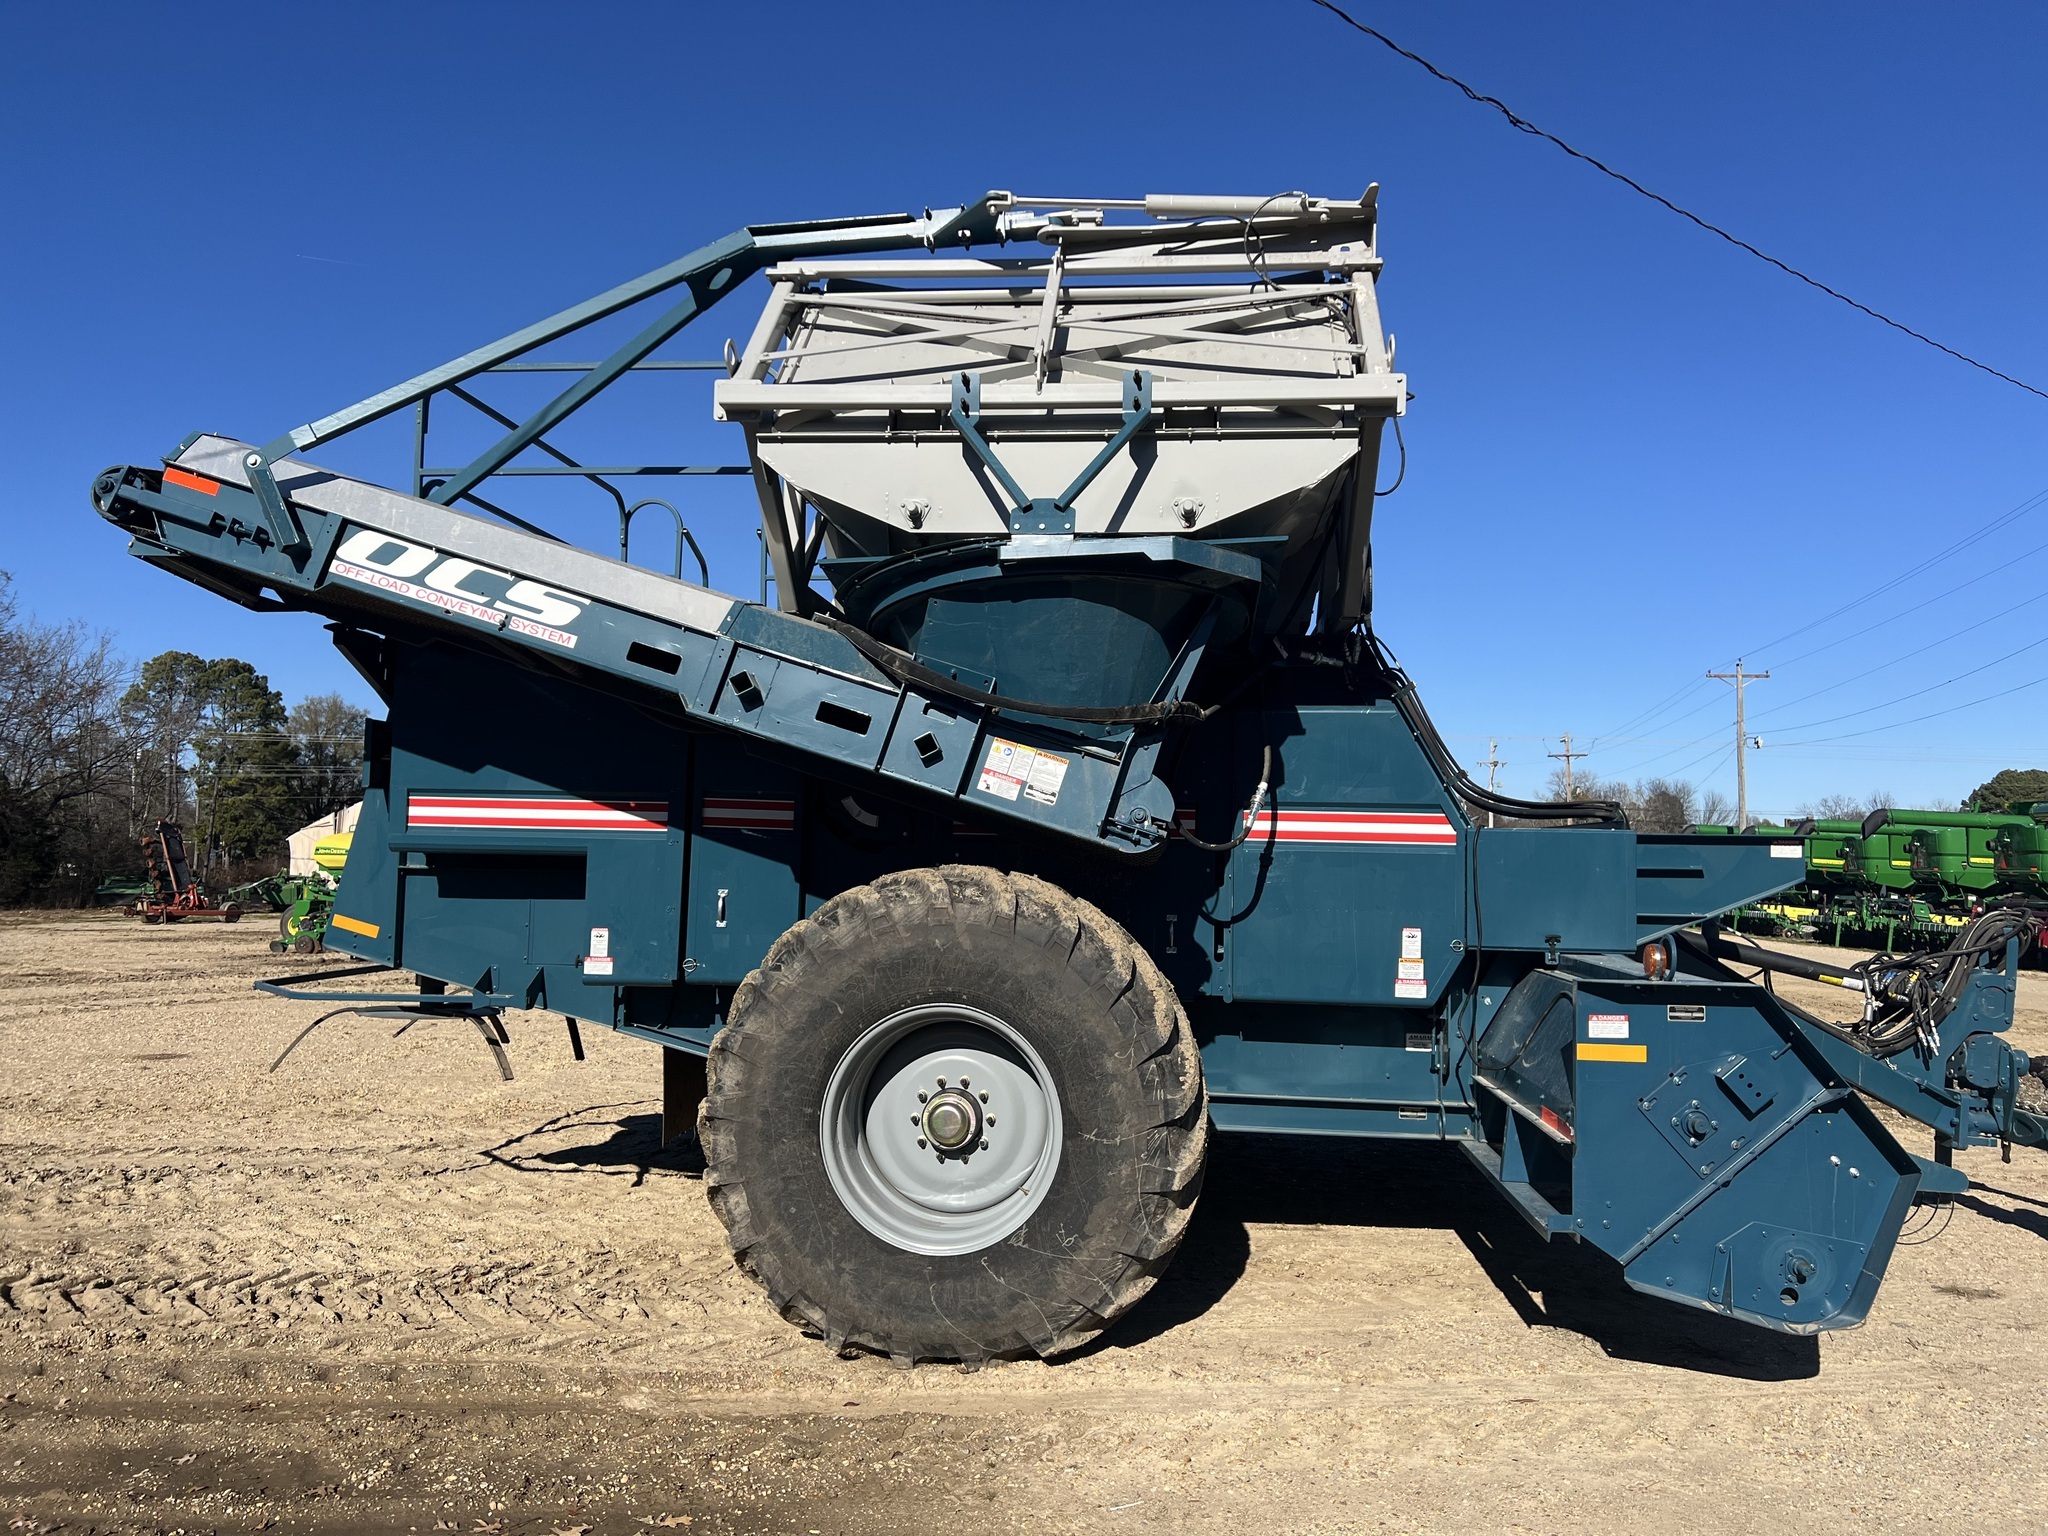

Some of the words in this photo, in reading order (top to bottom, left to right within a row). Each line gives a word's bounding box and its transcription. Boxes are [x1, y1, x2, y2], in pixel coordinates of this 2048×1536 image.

[336, 530, 591, 626] OCS
[335, 563, 410, 594] OFF-LOAD
[415, 589, 504, 624] CONVEYING
[510, 618, 572, 646] SYSTEM
[994, 771, 1017, 784] DANGER
[1043, 753, 1068, 765] WARNING
